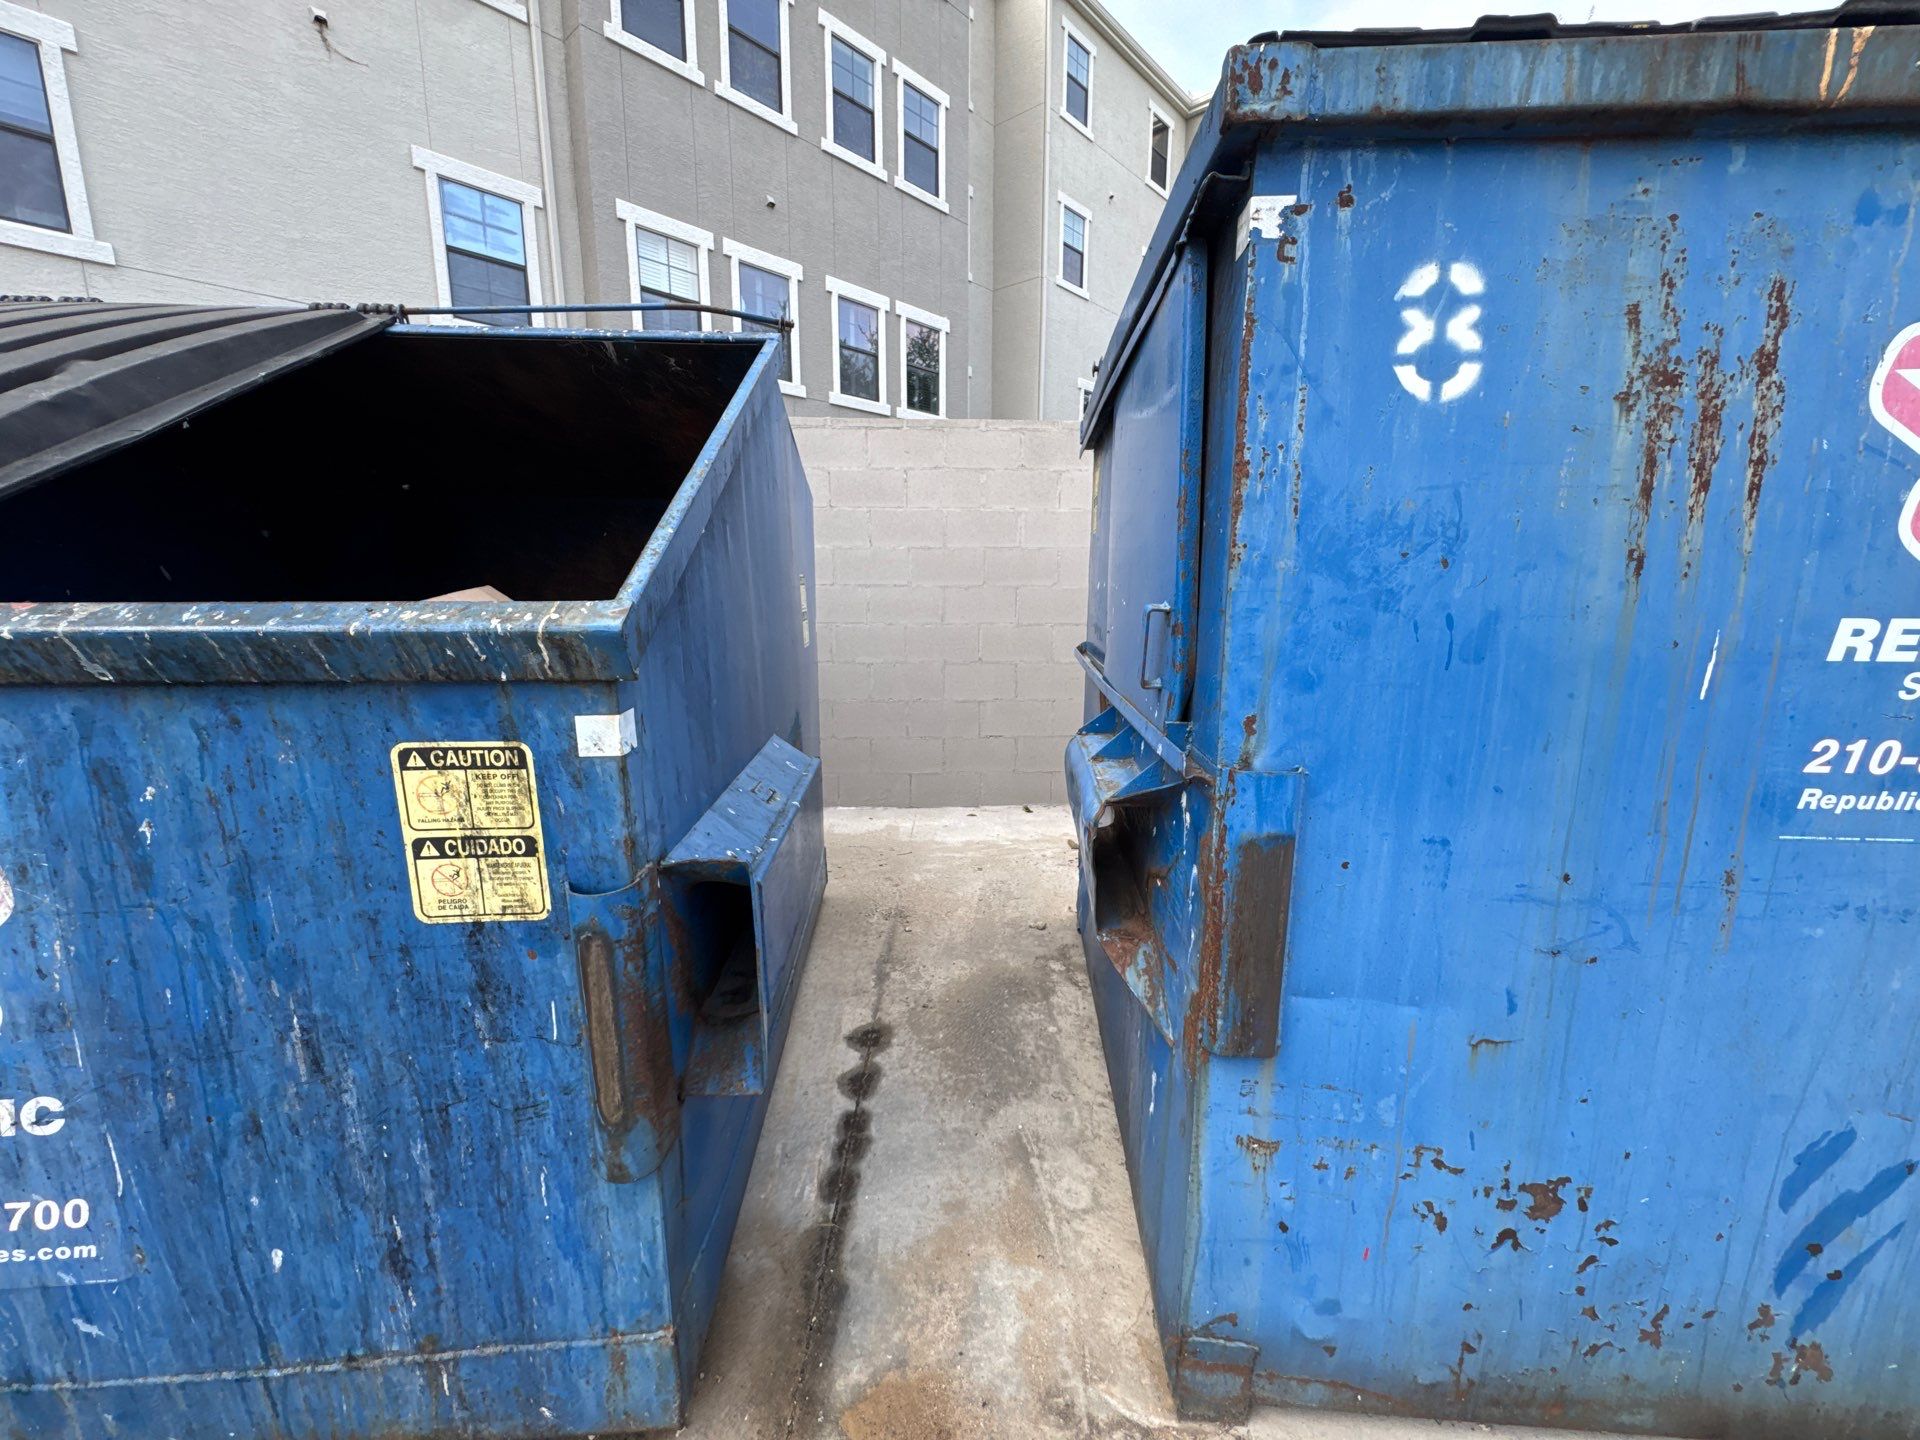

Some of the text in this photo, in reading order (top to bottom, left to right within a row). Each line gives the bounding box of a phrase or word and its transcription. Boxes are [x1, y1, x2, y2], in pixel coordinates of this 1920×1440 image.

[1393, 262, 1485, 403] 8
[430, 748, 520, 767] CAUTION
[1801, 738, 1920, 775] 210-
[475, 773, 499, 781] KEEP
[444, 838, 526, 856] CUIDADO
[3, 1199, 90, 1232] 700
